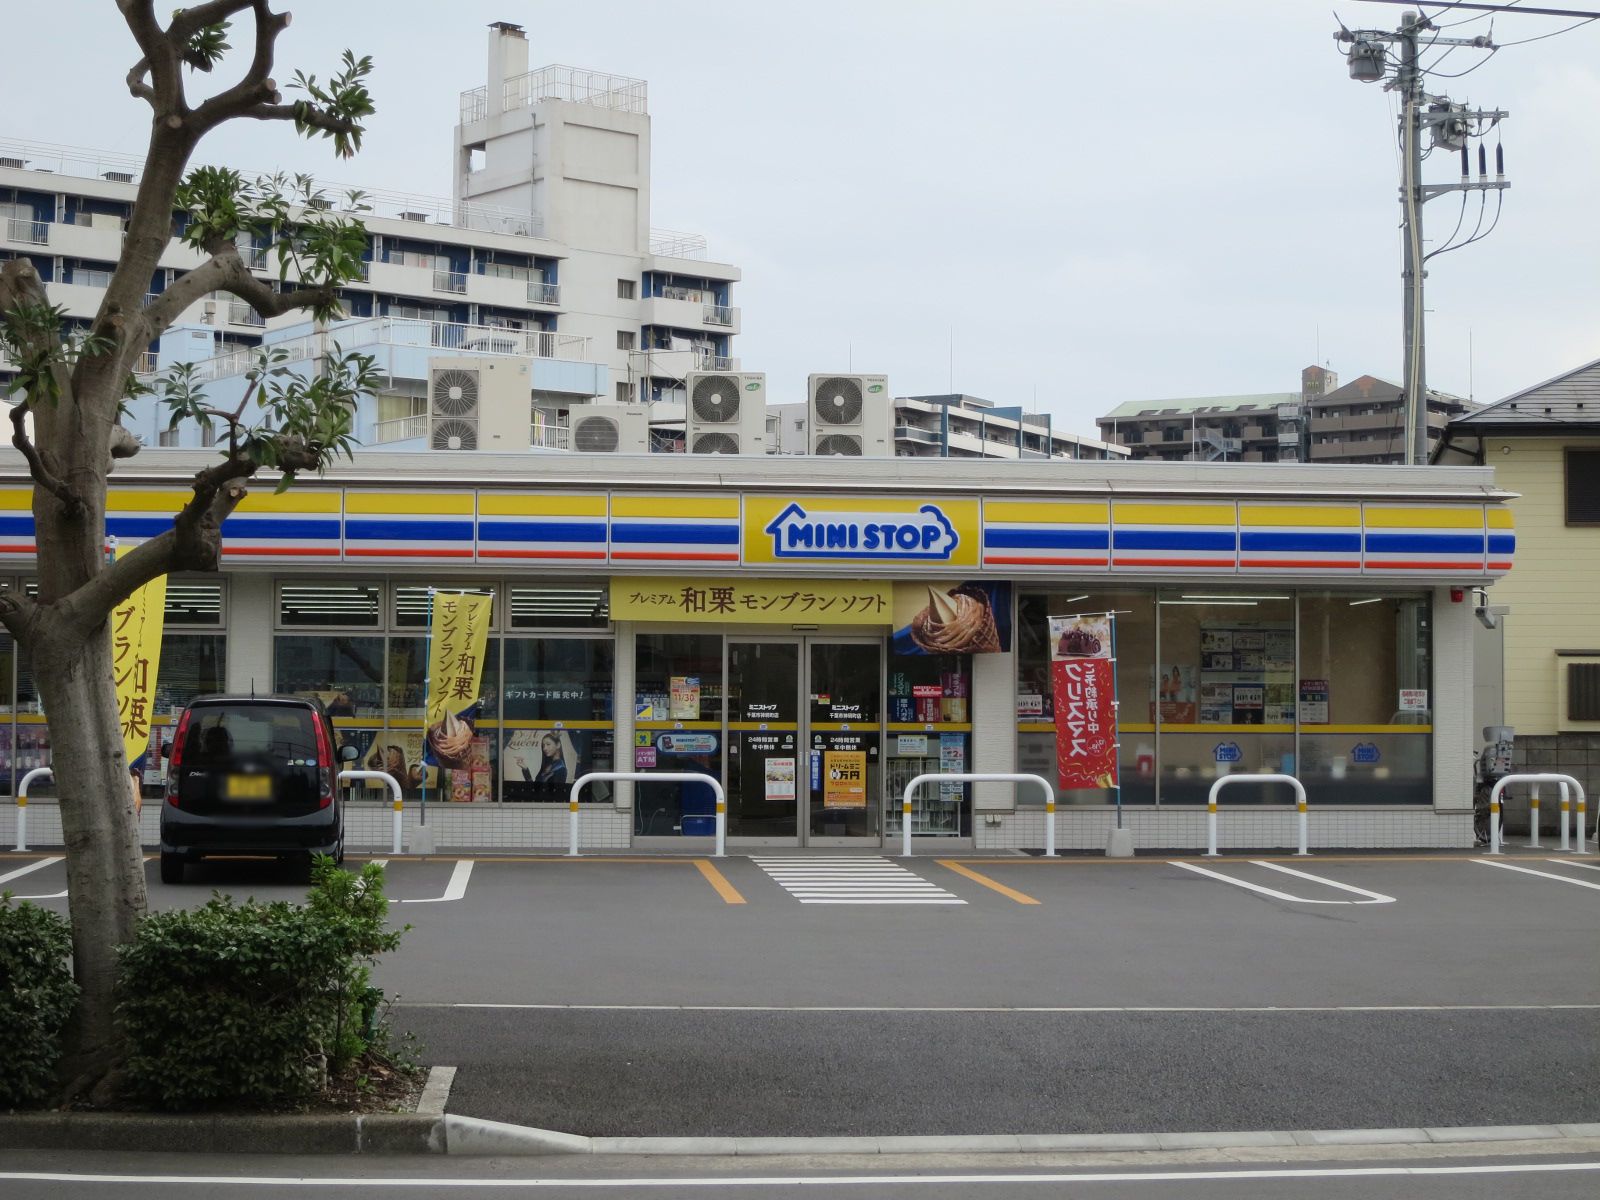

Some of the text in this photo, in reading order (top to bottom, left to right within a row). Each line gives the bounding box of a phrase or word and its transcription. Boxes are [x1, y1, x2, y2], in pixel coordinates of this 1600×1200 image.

[788, 522, 941, 550] MINI STOP
[629, 584, 887, 614] プレミアム和栗モンブランソフト
[433, 600, 458, 719] モンブランソフト
[452, 602, 479, 700] プレミアム和栗
[505, 690, 584, 700] ギフトカード販売中!
[674, 694, 695, 702] 11/30
